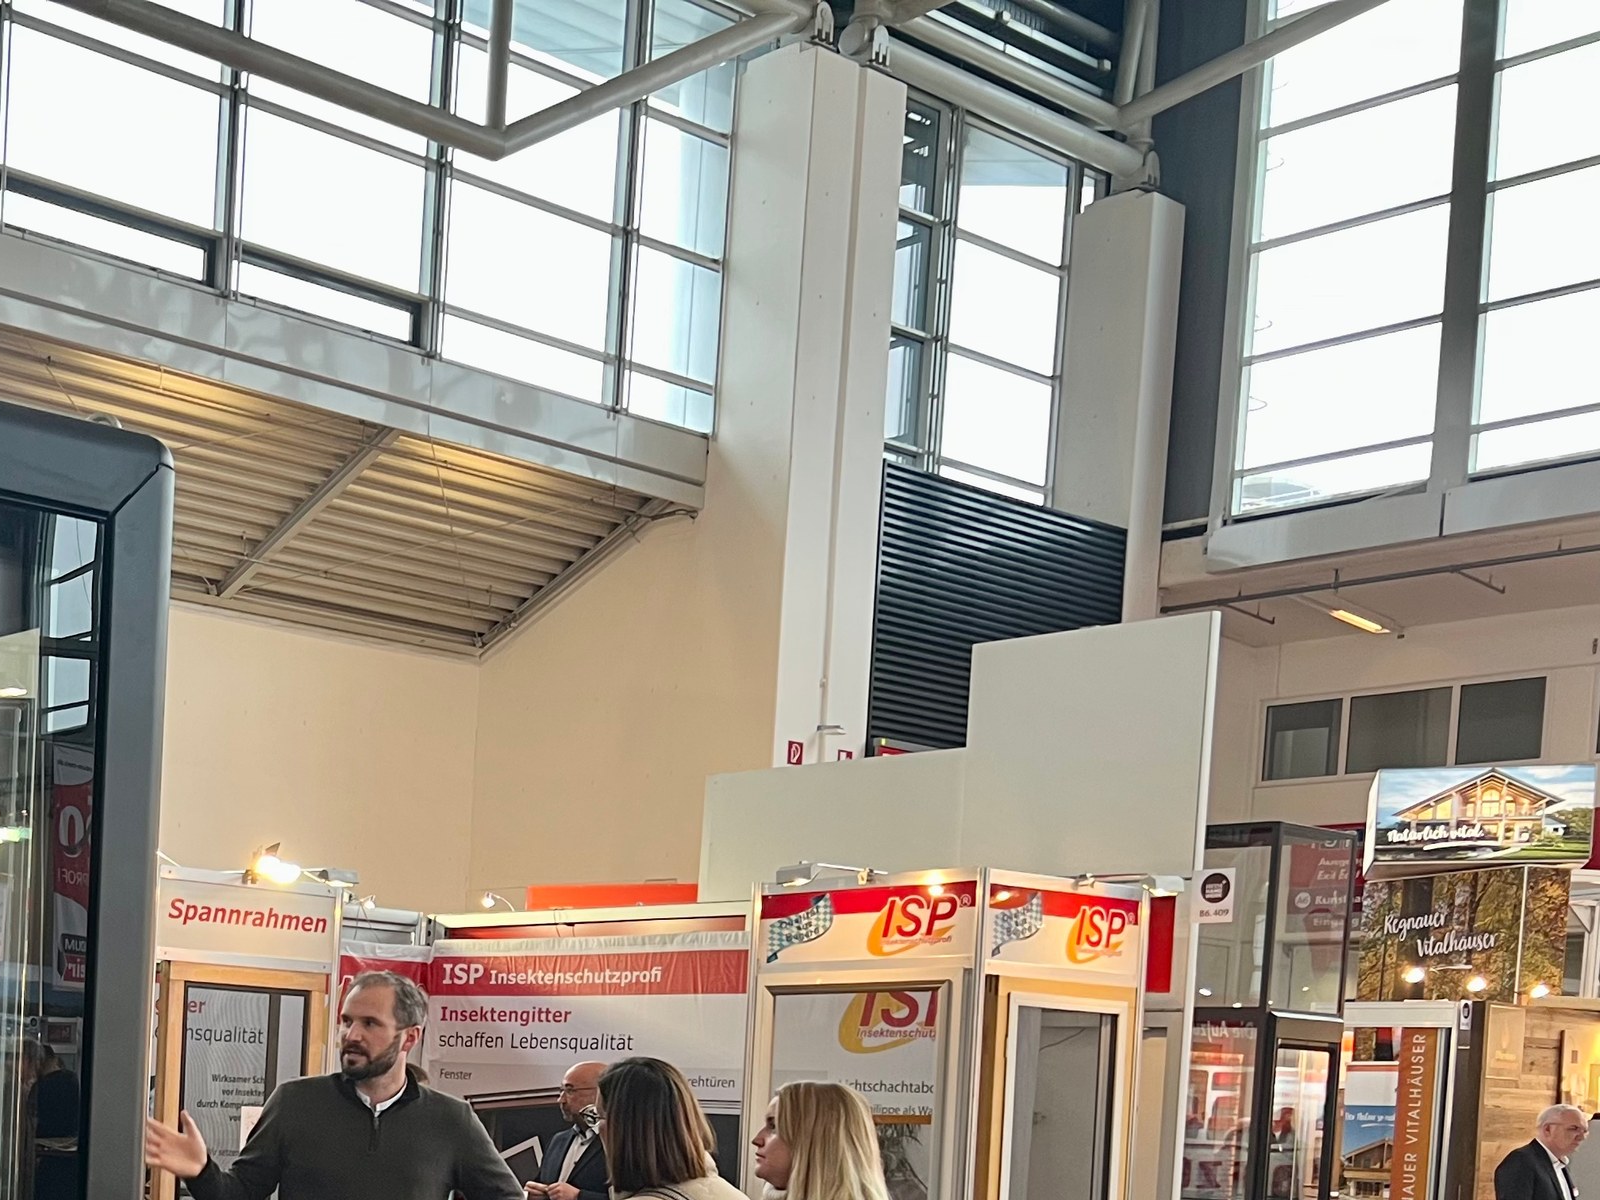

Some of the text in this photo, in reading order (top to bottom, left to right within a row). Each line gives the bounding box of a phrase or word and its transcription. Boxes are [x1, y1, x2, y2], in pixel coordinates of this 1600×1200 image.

[168, 898, 328, 934] Spannrahmen
[1384, 911, 1448, 942] Regnauer
[442, 963, 662, 987] ISP Insektenschutzprofi
[440, 1006, 572, 1027] Insektengitter
[186, 1026, 264, 1045] nsqualität
[439, 1032, 635, 1054] schaffen Lebensqualität
[252, 1076, 265, 1084] Sch
[439, 1068, 472, 1080] Fenster
[687, 1076, 736, 1089] rehtüren
[1404, 1033, 1427, 1145] VITALHÄUSER
[918, 1105, 933, 1116] Wa
